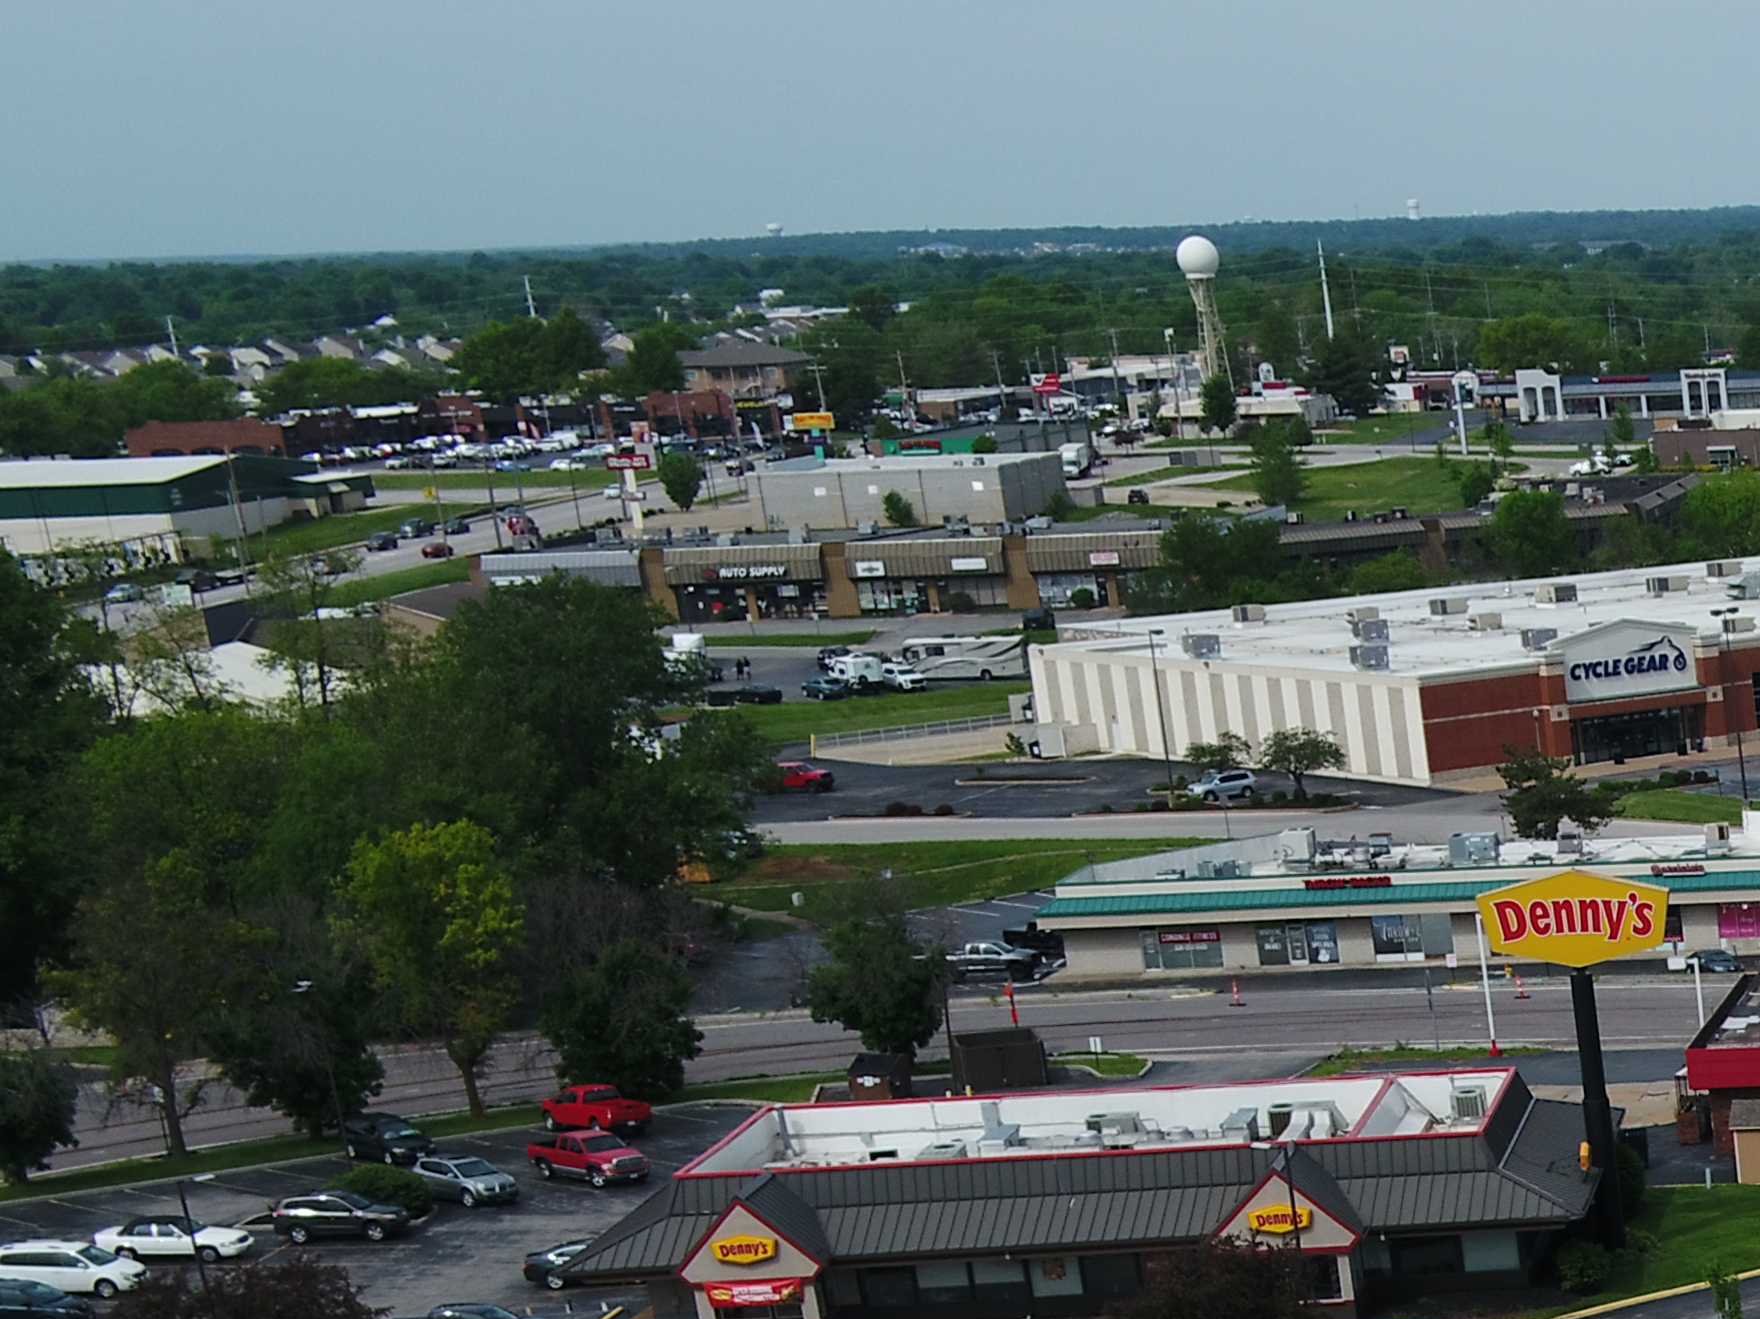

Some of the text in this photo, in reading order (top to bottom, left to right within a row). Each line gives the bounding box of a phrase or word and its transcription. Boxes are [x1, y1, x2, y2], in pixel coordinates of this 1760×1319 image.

[719, 565, 786, 579] AUTO SUPPLY
[1570, 653, 1669, 681] CYCLE GEAR
[1490, 890, 1655, 944] Denny's
[1255, 1209, 1304, 1228] Denny's
[718, 1241, 769, 1258] Denny's
